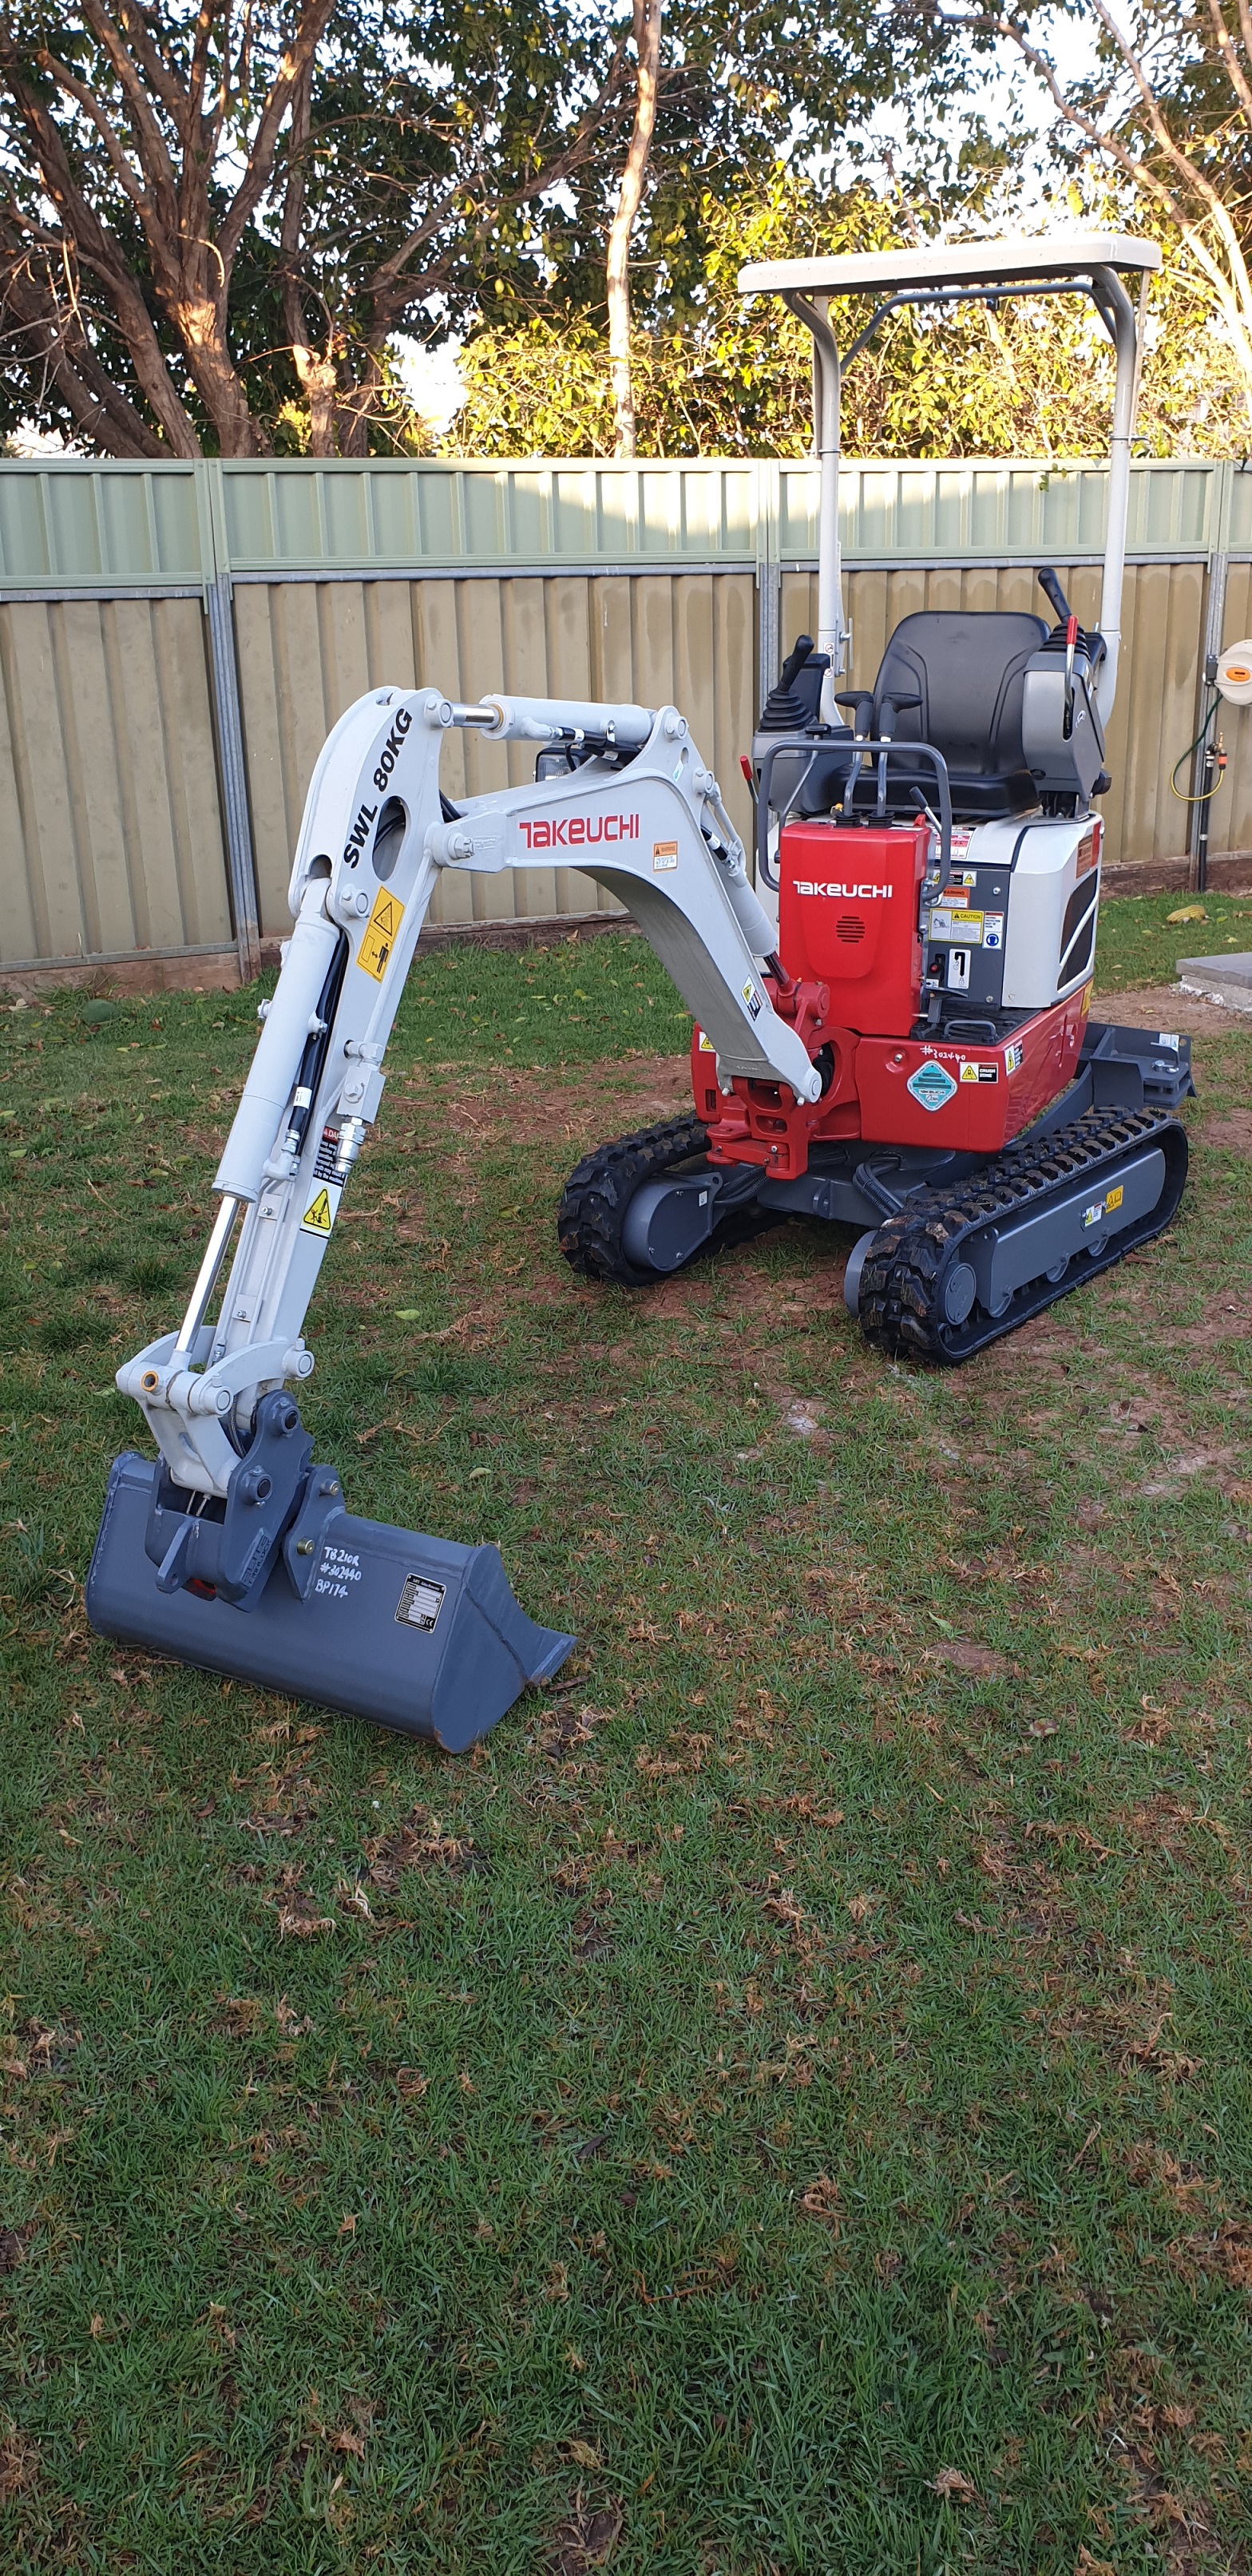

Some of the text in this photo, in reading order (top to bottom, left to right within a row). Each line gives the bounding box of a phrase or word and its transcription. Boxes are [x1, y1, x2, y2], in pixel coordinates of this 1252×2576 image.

[343, 708, 413, 869] SWL 80KG
[519, 814, 640, 849] TAKEUCHI
[792, 880, 893, 898] TAKEUCHI
[920, 1045, 965, 1063] #302440
[324, 1546, 359, 1567] TB210R
[319, 1562, 362, 1581] #302440
[315, 1578, 349, 1599] BP174
